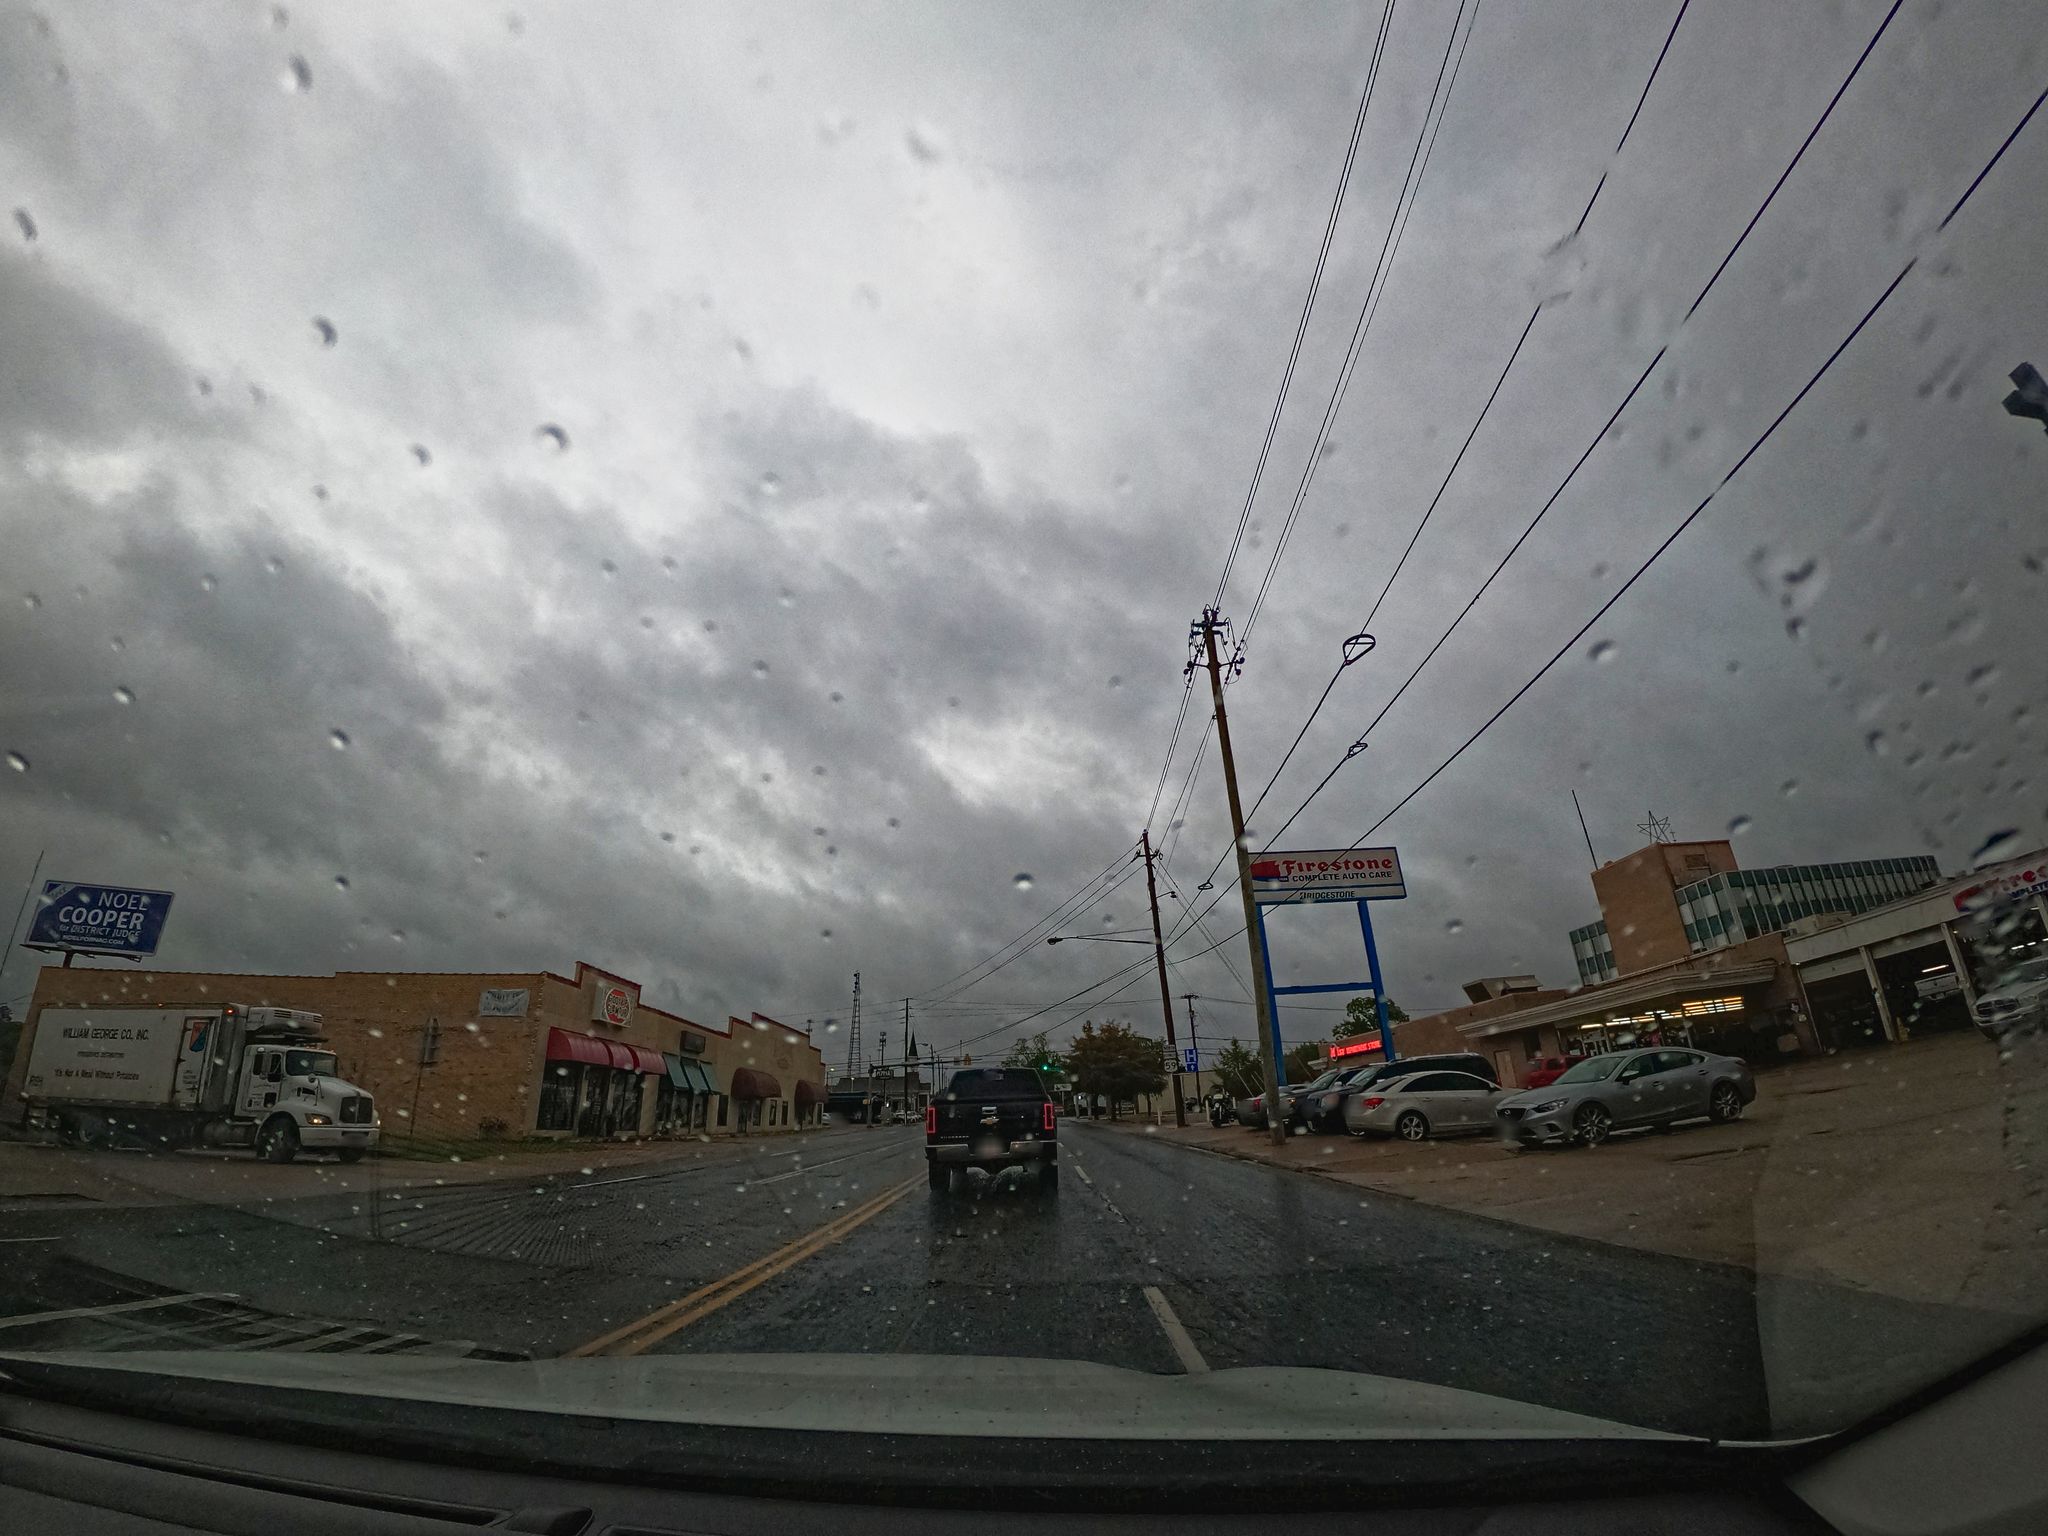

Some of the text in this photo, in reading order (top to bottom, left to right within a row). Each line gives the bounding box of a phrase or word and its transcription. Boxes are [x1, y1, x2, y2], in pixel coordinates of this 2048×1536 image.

[1282, 858, 1393, 876] Firestone
[1292, 870, 1393, 883] COMPLETE AUTO CARE
[98, 892, 148, 911] NOEL
[1300, 890, 1356, 900] BRIDGESTONE
[58, 906, 145, 930] COOPER
[70, 926, 110, 937] DISTRICT
[112, 928, 141, 940] JUDGE
[91, 1028, 119, 1040] GEORGE
[1186, 1049, 1197, 1062] H
[1165, 1061, 1176, 1070] 59
